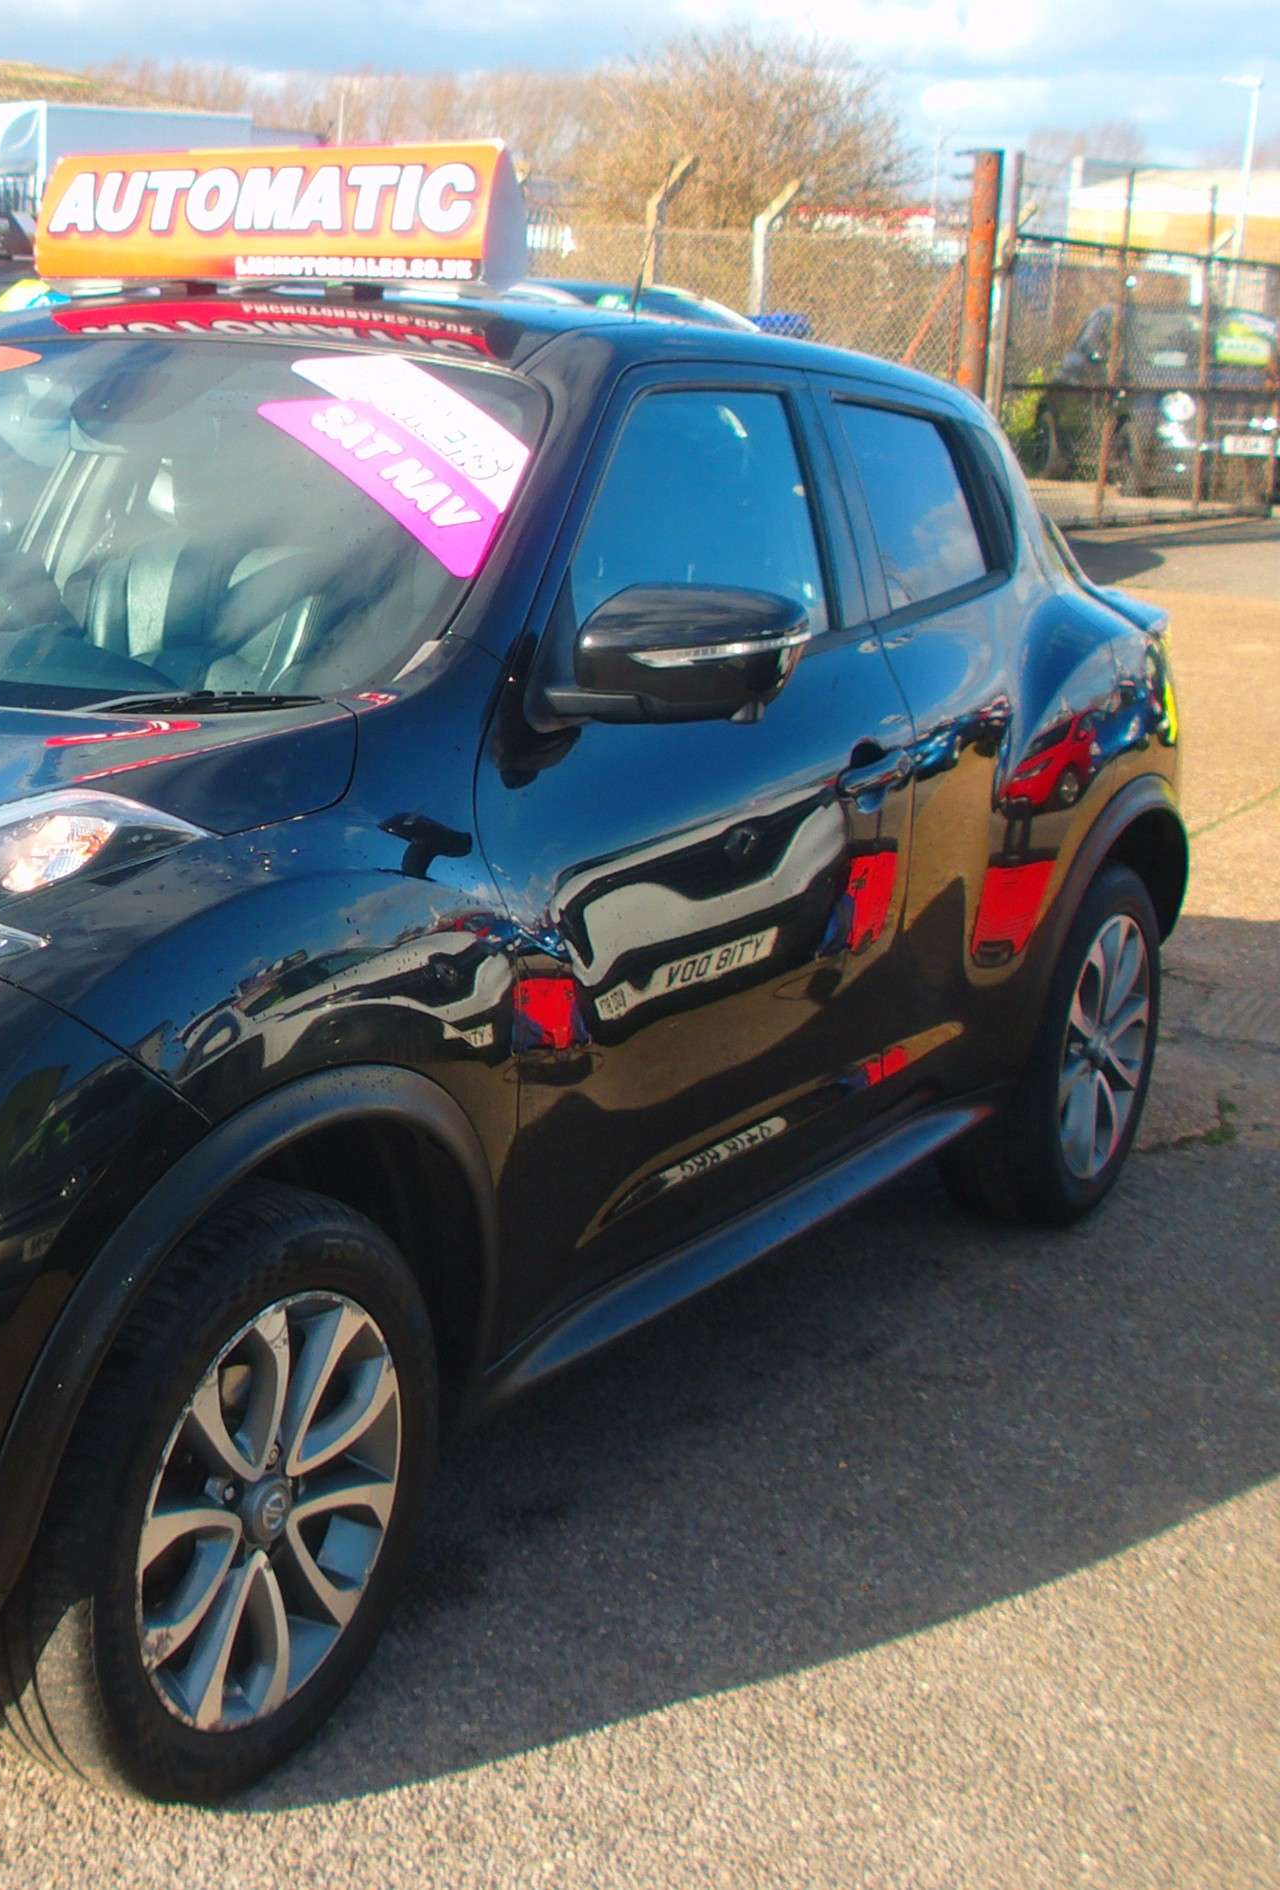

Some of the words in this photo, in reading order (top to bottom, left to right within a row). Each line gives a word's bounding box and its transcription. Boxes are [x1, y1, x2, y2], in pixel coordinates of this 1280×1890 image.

[47, 162, 479, 236] AUTOMATIC
[308, 404, 404, 461] SAT
[377, 457, 484, 528] NAV
